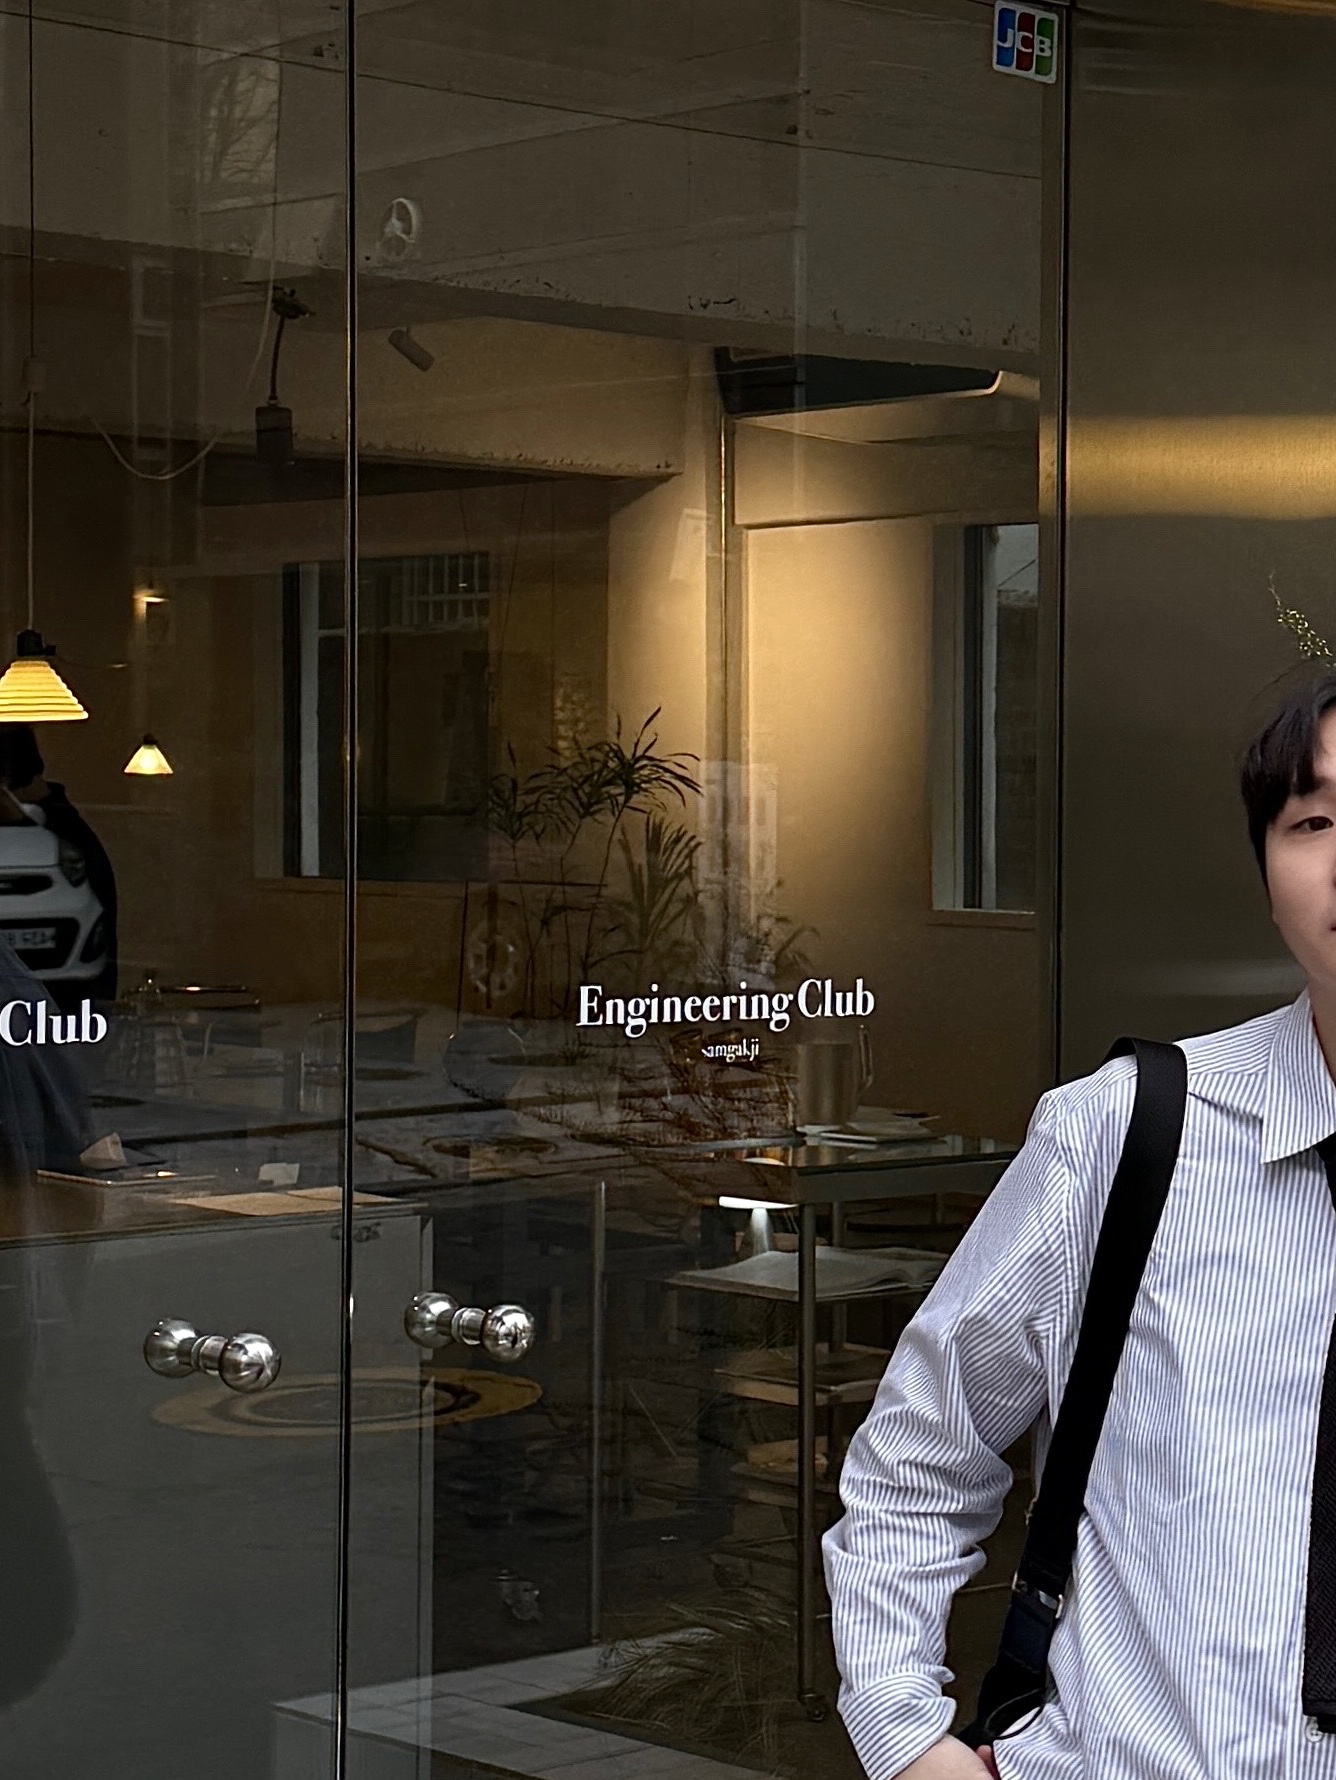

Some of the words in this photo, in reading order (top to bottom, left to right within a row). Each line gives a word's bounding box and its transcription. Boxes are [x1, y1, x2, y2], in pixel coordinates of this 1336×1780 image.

[997, 28, 1053, 57] JCB
[0, 998, 108, 1047] Club
[576, 982, 795, 1038] Engineering
[797, 978, 876, 1018] Club
